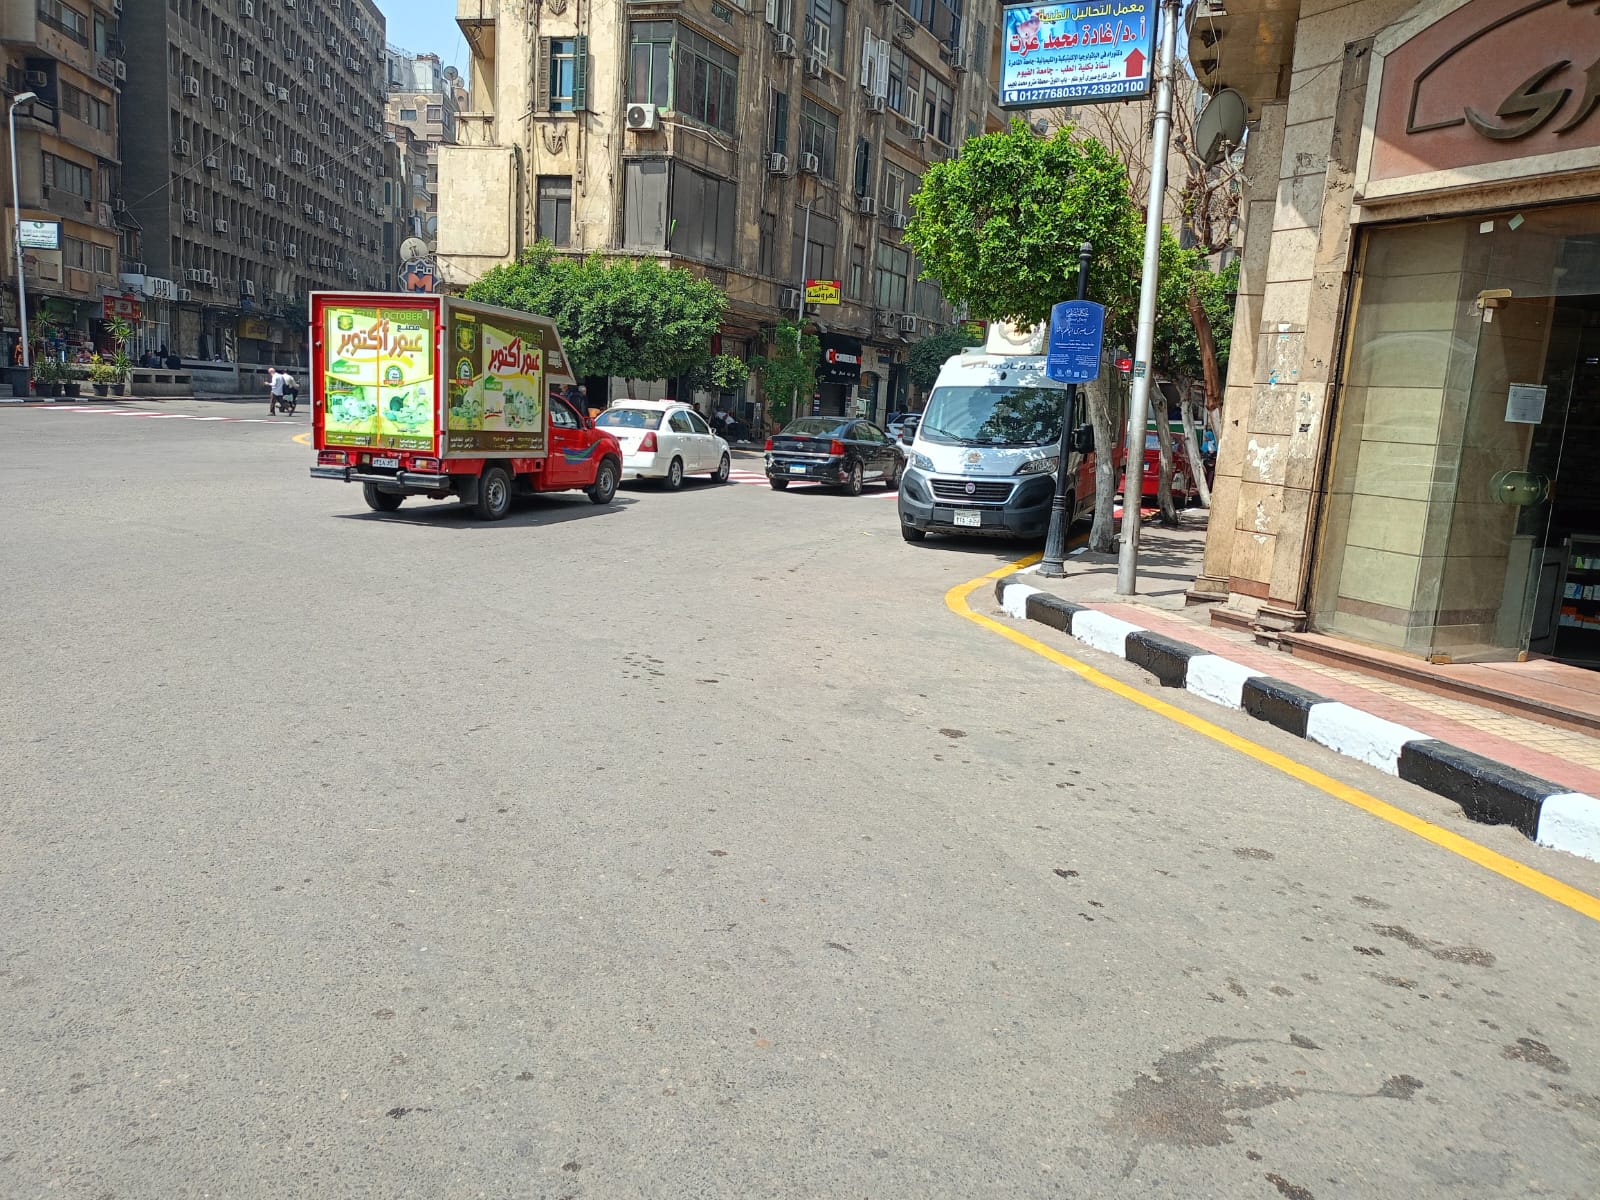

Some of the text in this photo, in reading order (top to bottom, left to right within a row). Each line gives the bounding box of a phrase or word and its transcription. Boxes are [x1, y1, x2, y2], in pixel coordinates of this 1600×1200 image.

[1038, 3, 1145, 25] معمل التحاليل الطبية
[1009, 33, 1040, 57] عزت
[1043, 31, 1079, 49] محمد
[1060, 64, 1077, 74] الطب
[1078, 63, 1094, 72] بكلية
[1095, 59, 1111, 69] أستاذ
[1016, 68, 1035, 78] الفيوم
[1036, 66, 1054, 76] جامعة
[1019, 80, 1145, 101] 01277680337-23920100
[383, 311, 423, 321] OCTOBER
[397, 323, 420, 333] مصنع
[336, 319, 423, 358] عبور أكتوبر
[488, 335, 540, 377] عبور أكتوبر
